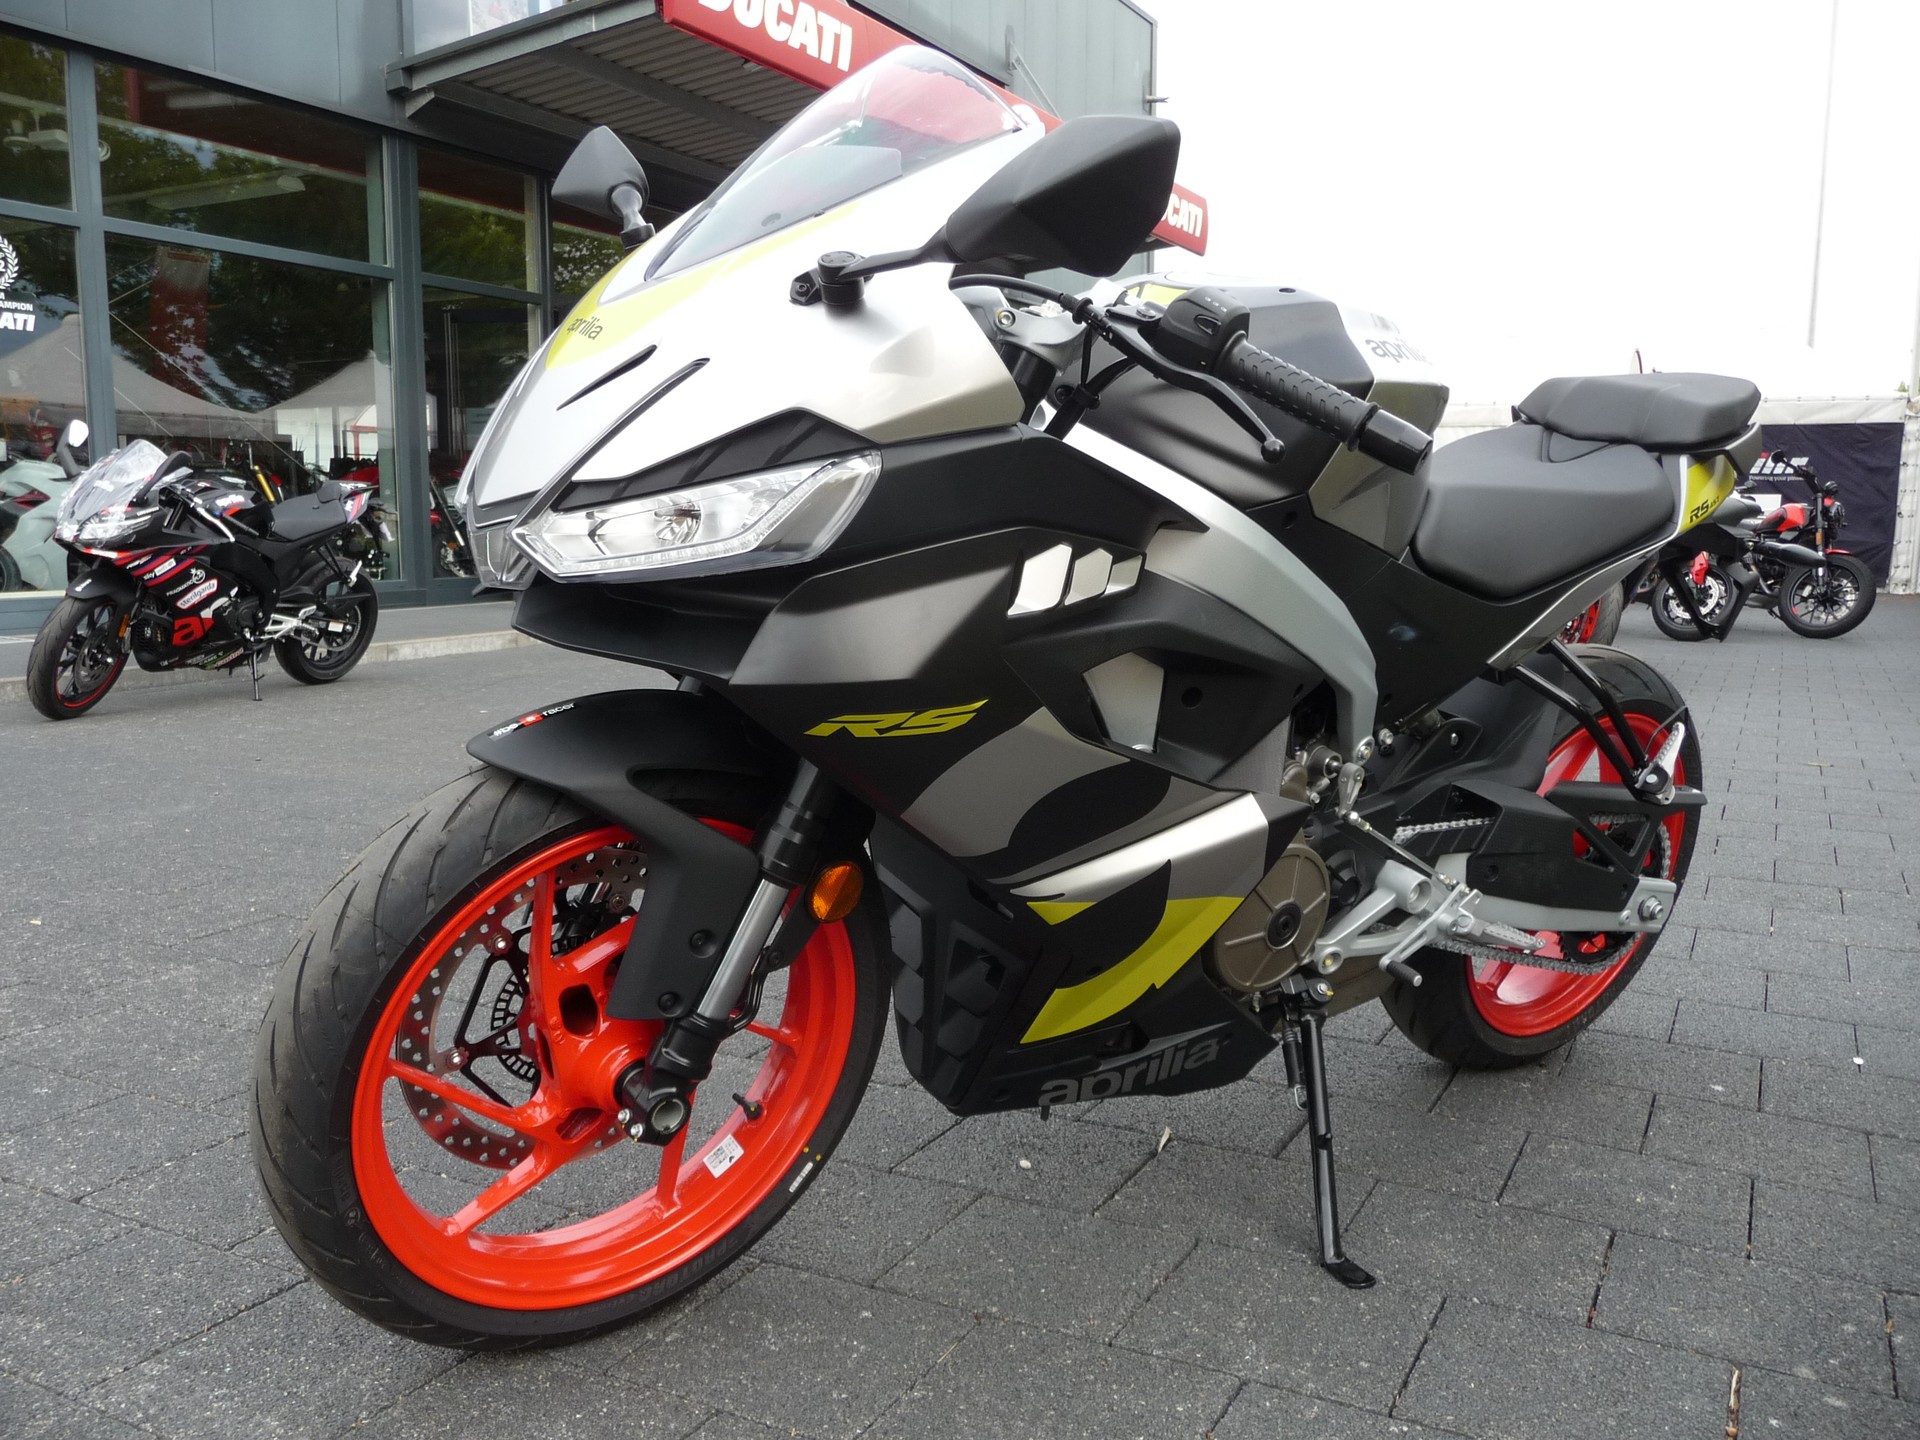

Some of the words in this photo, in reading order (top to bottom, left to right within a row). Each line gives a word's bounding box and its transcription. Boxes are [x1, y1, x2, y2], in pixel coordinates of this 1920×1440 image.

[1161, 192, 1203, 238] CATI
[566, 316, 603, 341] aprilia
[1689, 499, 1710, 523] RS
[180, 582, 216, 608] sterilgarda
[803, 698, 989, 738] RS
[1038, 1038, 1220, 1106] aprilia
